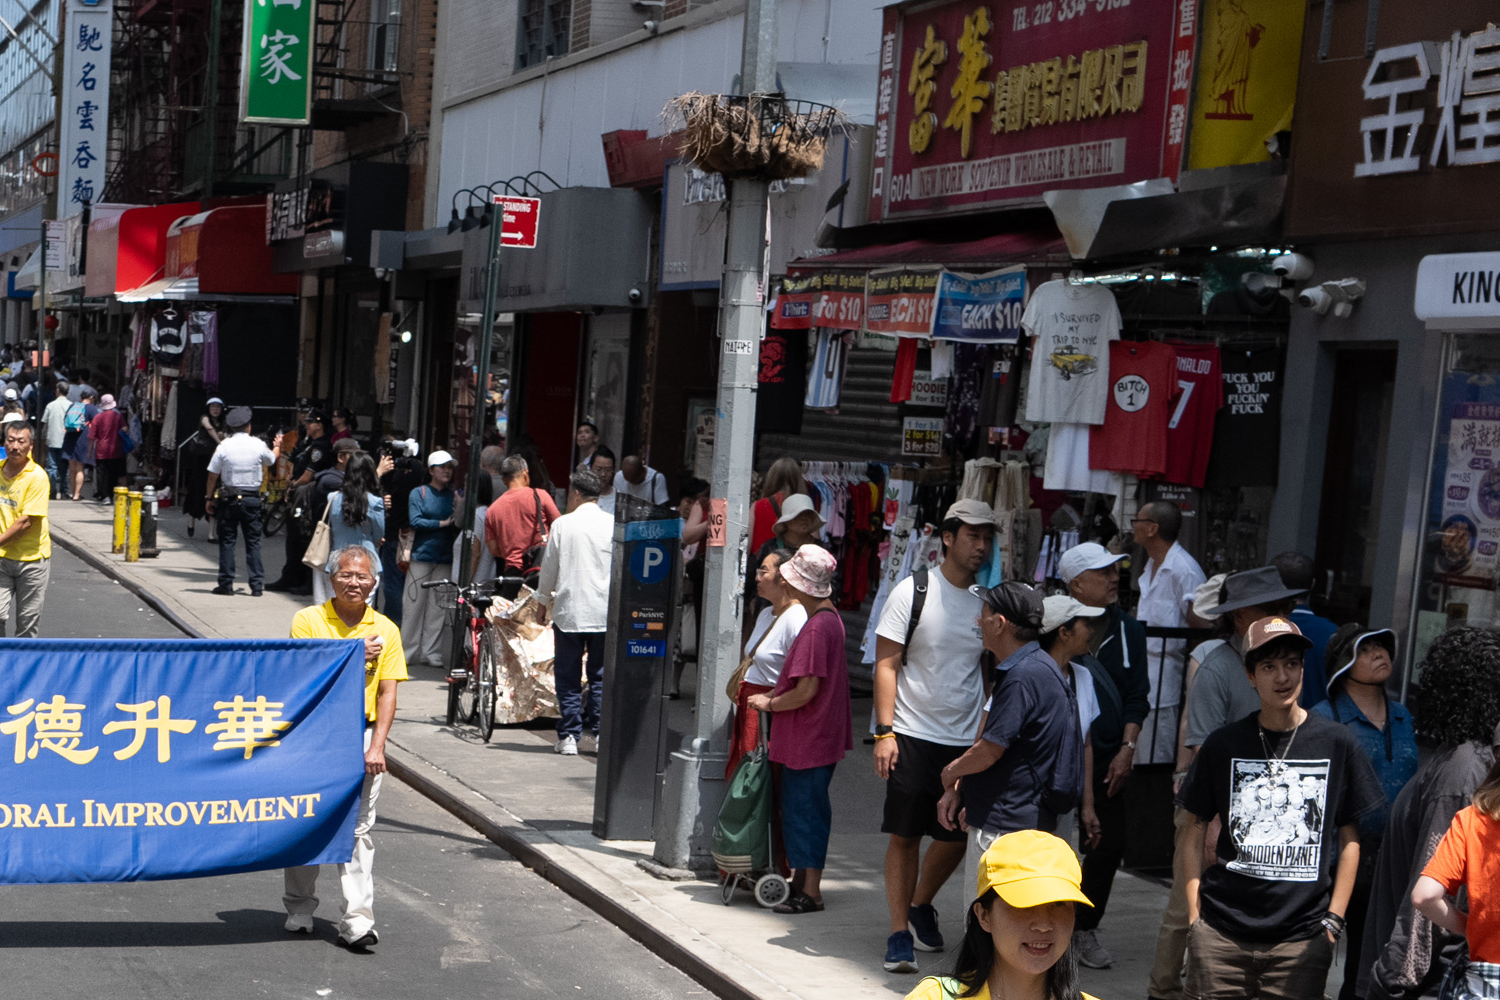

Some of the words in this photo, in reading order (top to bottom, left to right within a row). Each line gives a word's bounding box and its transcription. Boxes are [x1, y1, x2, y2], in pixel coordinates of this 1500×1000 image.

[257, 0, 303, 85] 家
[890, 173, 912, 203] 60A
[919, 168, 938, 197] NEW
[940, 165, 965, 194] YORK
[969, 157, 1011, 191] SOUVENIR
[1014, 149, 1065, 184] WHOLESALE
[1068, 147, 1076, 177] &
[1078, 141, 1113, 176] RETAIL
[502, 202, 531, 213] STANDING
[818, 294, 838, 319] For
[839, 295, 861, 323] $10
[961, 303, 995, 330] EACH
[995, 301, 1022, 332] $10
[1061, 312, 1101, 324] SURVIVED
[1068, 324, 1079, 333] MY
[1052, 334, 1068, 345] TRIP
[1071, 335, 1079, 344] TO
[1252, 371, 1275, 382] YOU
[1117, 380, 1148, 395] BITCH
[1235, 384, 1260, 393] YOU
[1126, 393, 1136, 406] 1
[1168, 379, 1196, 429] 7
[1231, 404, 1264, 414] FUCK
[915, 420, 927, 429] for
[913, 430, 925, 439] for
[912, 442, 924, 451] for
[925, 443, 939, 453] $20
[642, 546, 664, 578] P
[638, 610, 665, 619] ParkNYC
[630, 645, 657, 654] 101641
[82, 792, 322, 828] IMPROVEMENT
[1284, 845, 1319, 866] PLANET
